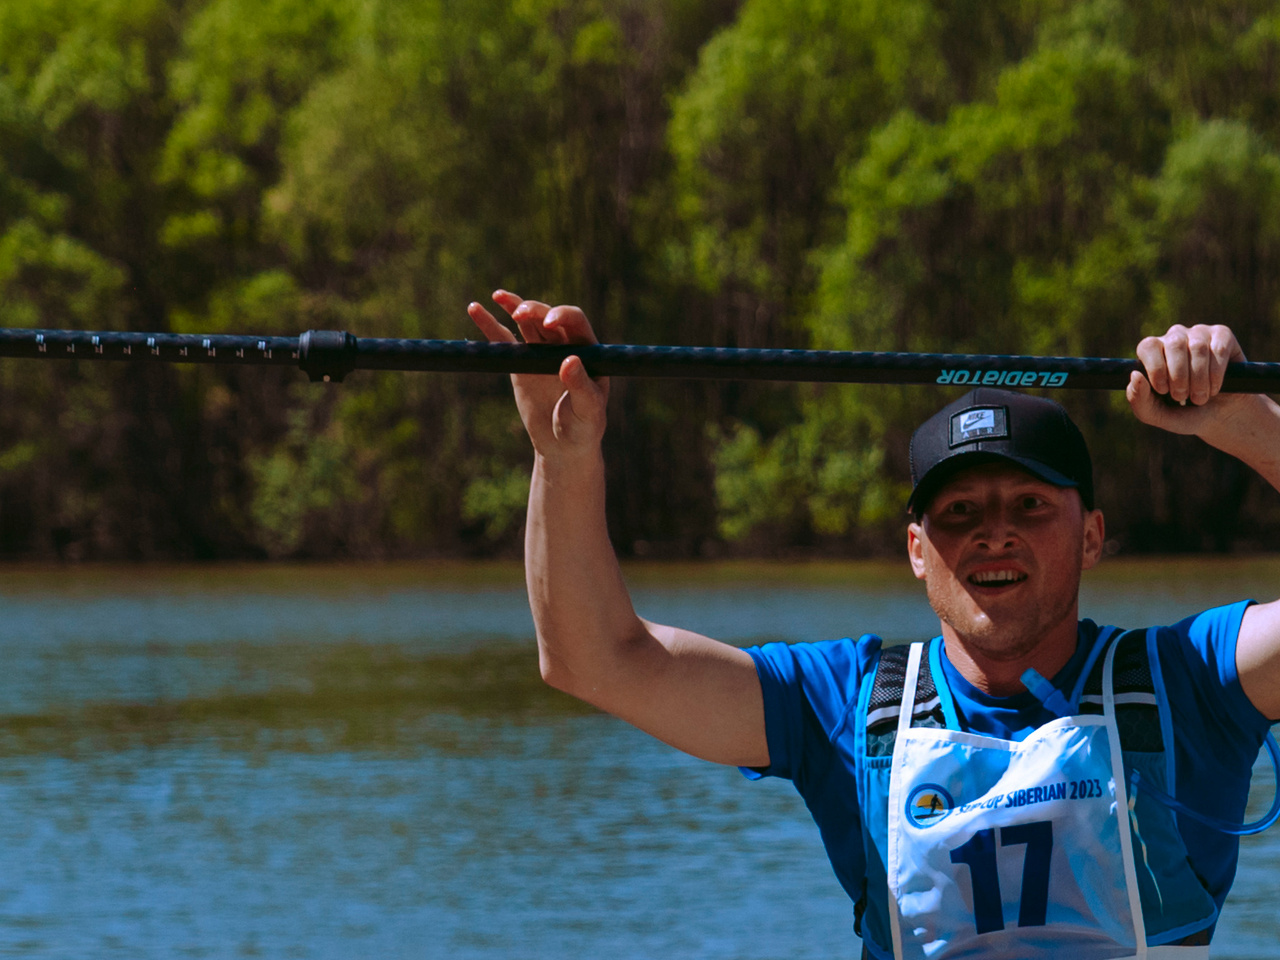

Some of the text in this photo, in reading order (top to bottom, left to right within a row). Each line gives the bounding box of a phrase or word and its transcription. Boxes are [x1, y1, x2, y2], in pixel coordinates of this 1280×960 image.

[968, 411, 985, 420] NIKE
[1004, 782, 1067, 809] SIBERIAN
[1069, 779, 1103, 800] 2023
[950, 820, 1054, 935] 17
